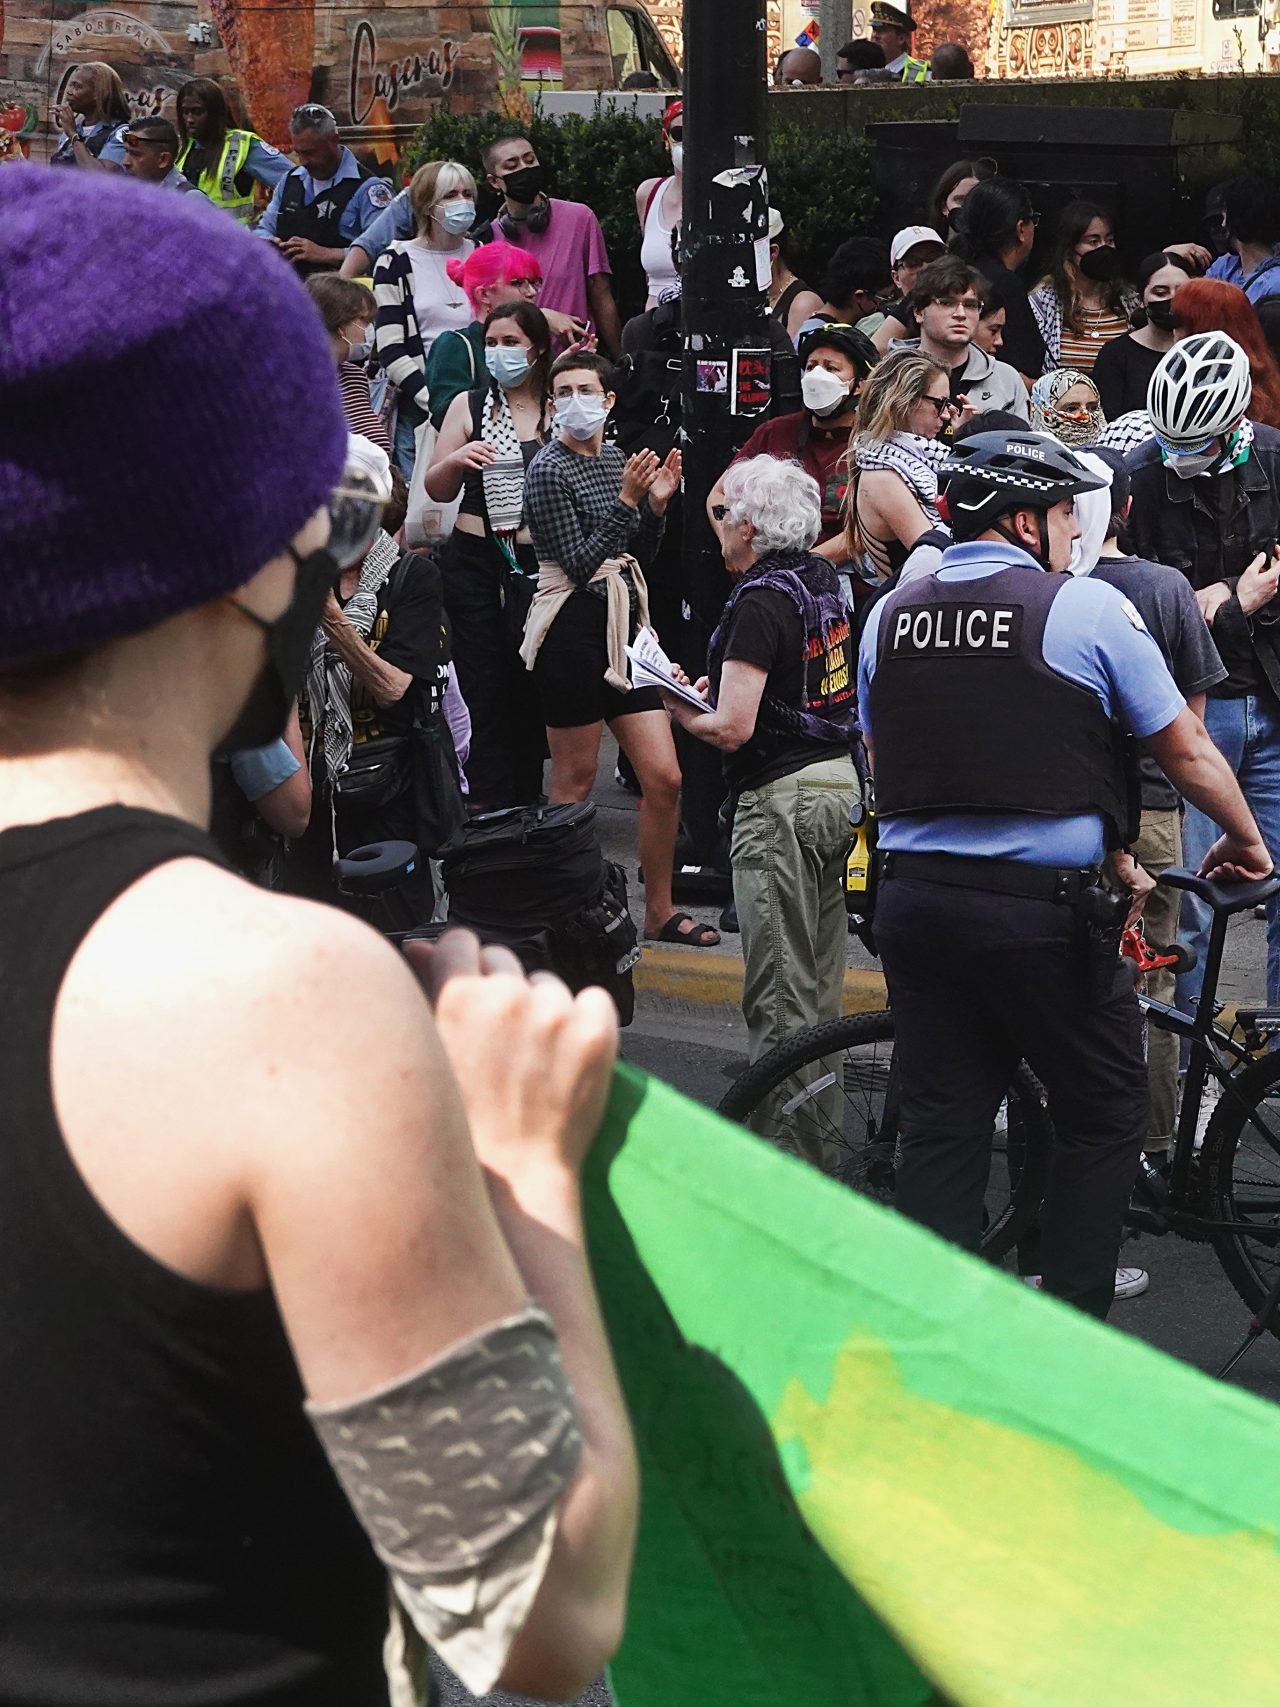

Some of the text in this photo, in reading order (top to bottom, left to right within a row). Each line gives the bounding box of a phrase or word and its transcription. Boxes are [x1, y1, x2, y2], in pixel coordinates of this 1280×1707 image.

[57, 21, 150, 50] SABOR REAL
[1006, 444, 1045, 461] POLICE
[893, 609, 1013, 650] POLICE
